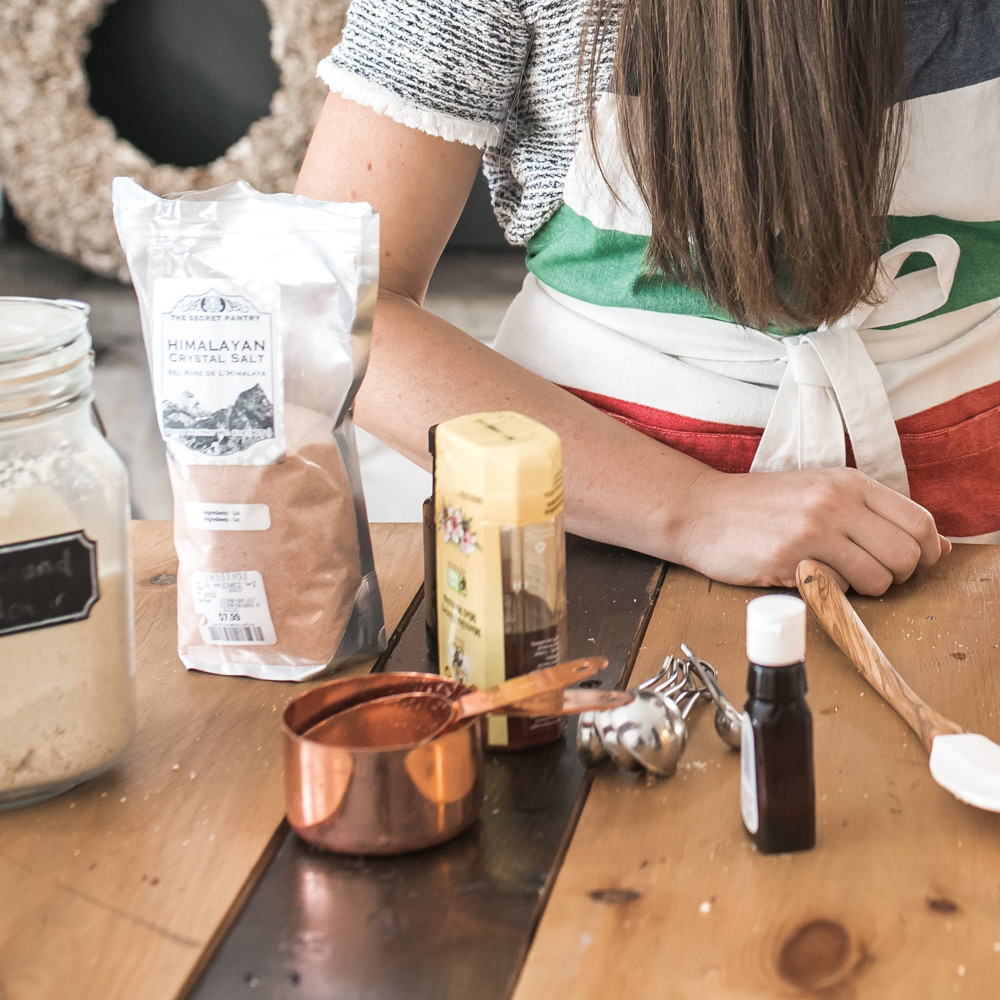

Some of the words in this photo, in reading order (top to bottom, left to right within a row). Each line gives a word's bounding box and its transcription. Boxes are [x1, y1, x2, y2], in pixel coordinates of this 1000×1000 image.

[167, 339, 266, 351] HIMALAYAN
[169, 352, 226, 363] CRYSTAL
[231, 353, 265, 363] SALT
